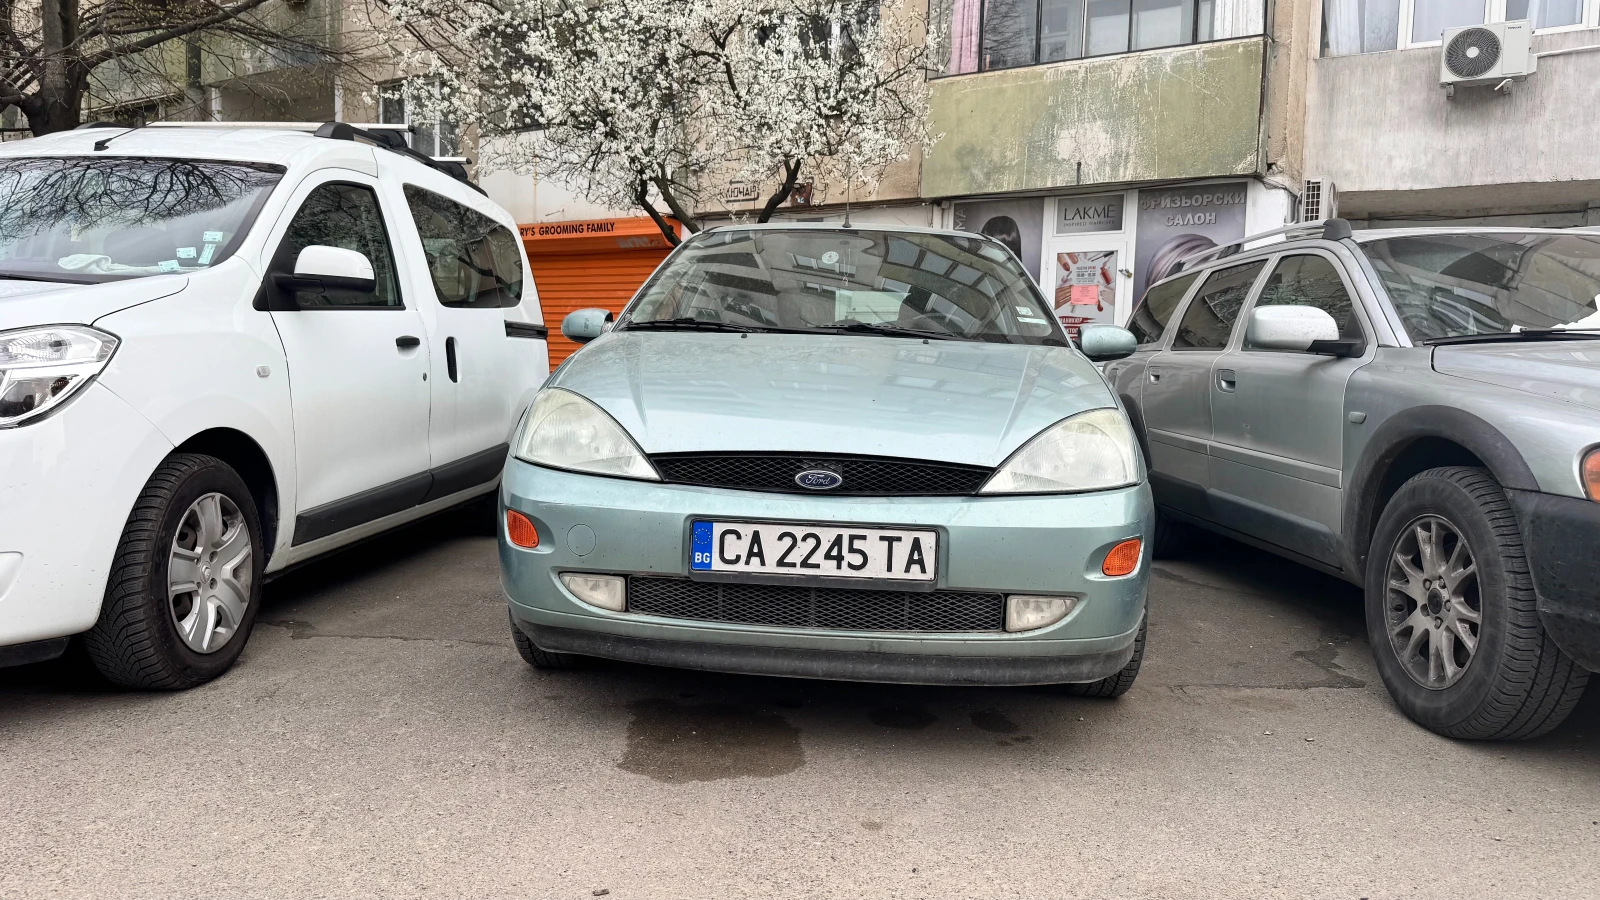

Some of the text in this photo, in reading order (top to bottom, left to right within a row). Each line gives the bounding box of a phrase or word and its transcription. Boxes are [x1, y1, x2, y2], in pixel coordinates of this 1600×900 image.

[1140, 192, 1246, 210] ФРИЗЬОРСКИ
[1064, 204, 1116, 220] LAKME
[1165, 212, 1216, 227] САЛОН
[538, 224, 584, 236] GROOMING
[586, 222, 615, 233] FAMILY
[806, 474, 831, 485] Ford
[694, 552, 711, 564] BG
[718, 528, 927, 574] CA 2245 TA
